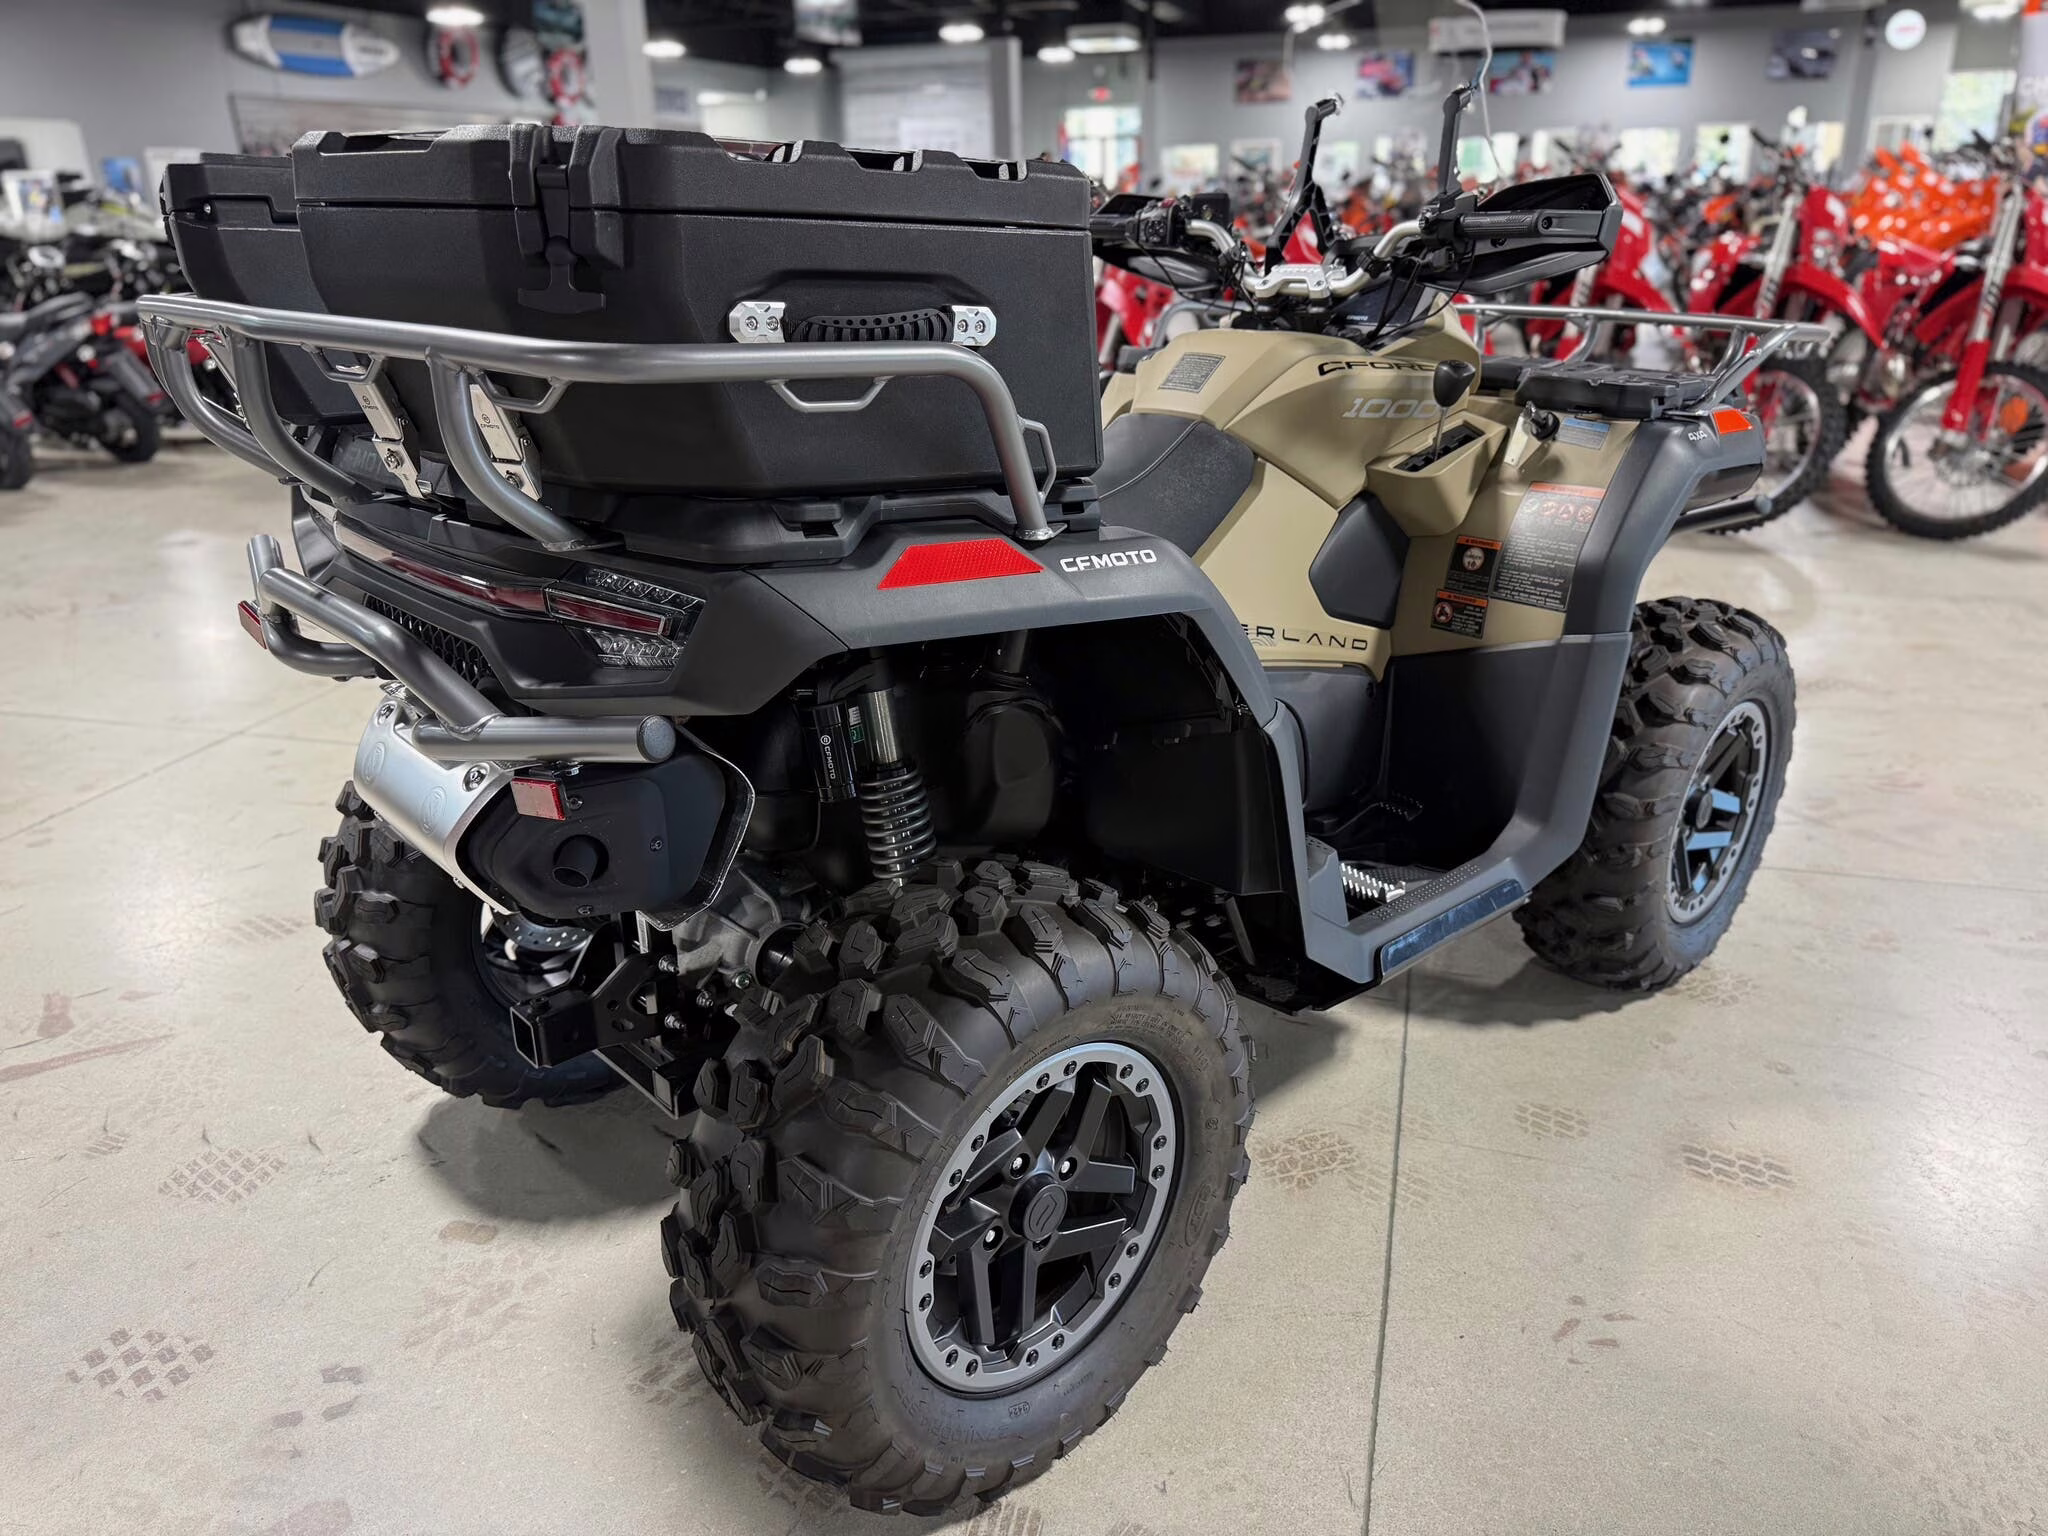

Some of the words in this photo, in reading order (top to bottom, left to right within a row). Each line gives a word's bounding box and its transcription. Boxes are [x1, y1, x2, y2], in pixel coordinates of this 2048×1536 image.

[1318, 361, 1435, 376] CFORC
[1342, 398, 1440, 419] 1000
[1060, 549, 1158, 573] CFMOTO
[1241, 623, 1369, 651] RLAND
[824, 746, 836, 779] CFMOTO
